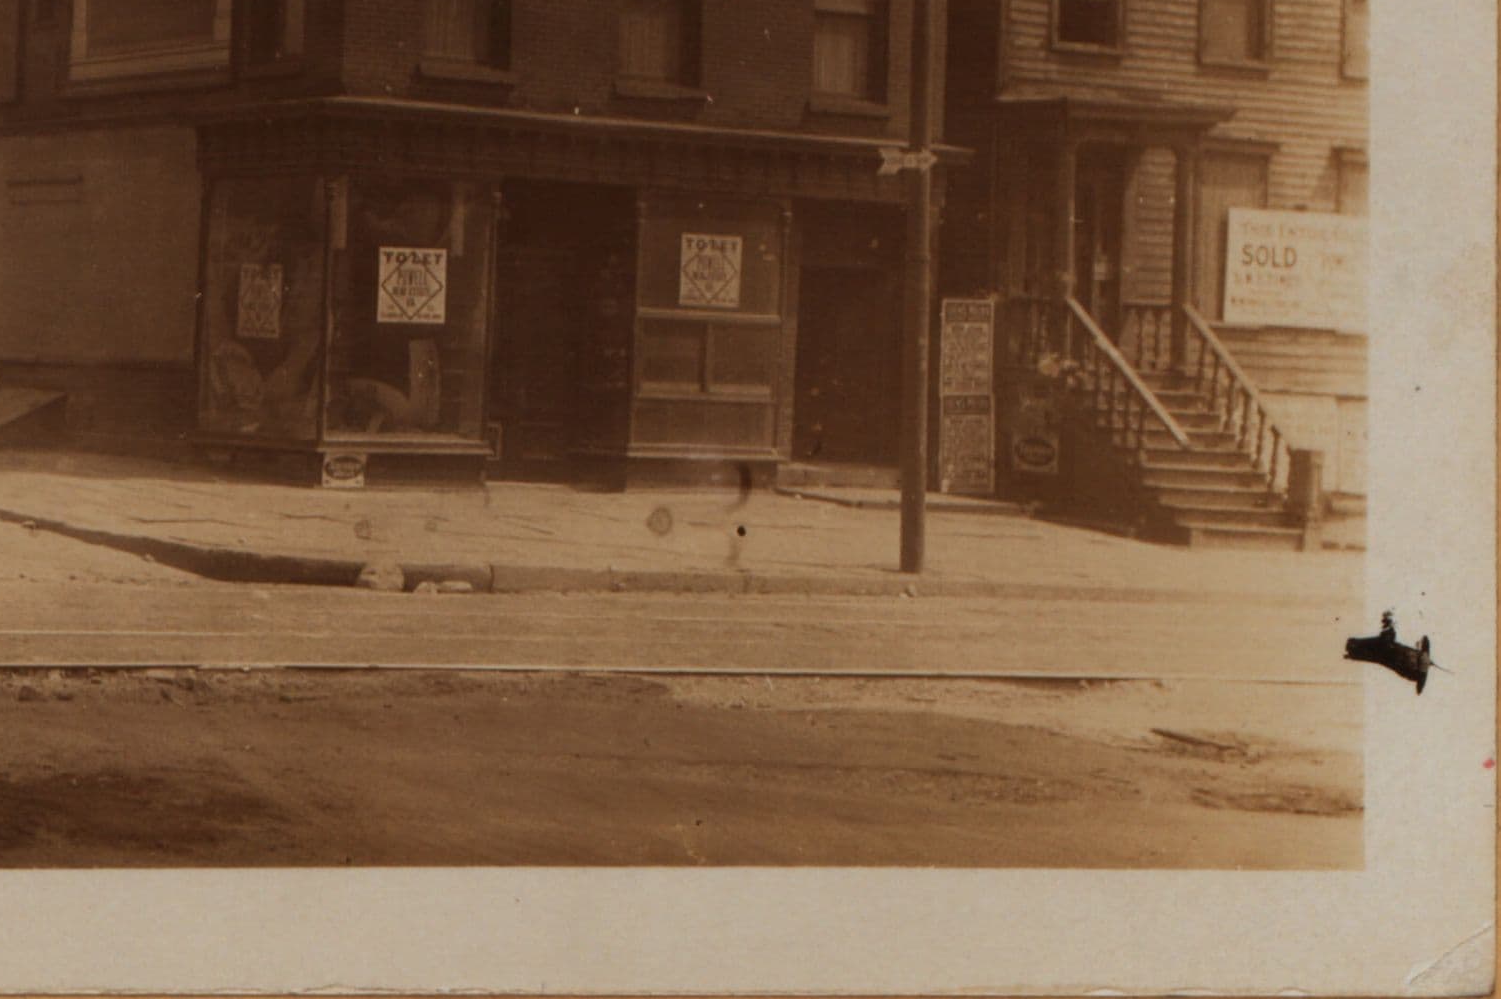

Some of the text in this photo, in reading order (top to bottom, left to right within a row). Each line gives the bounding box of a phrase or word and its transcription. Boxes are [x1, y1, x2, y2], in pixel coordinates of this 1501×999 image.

[383, 251, 443, 265] TO LET
[1242, 244, 1298, 268] SOLD
